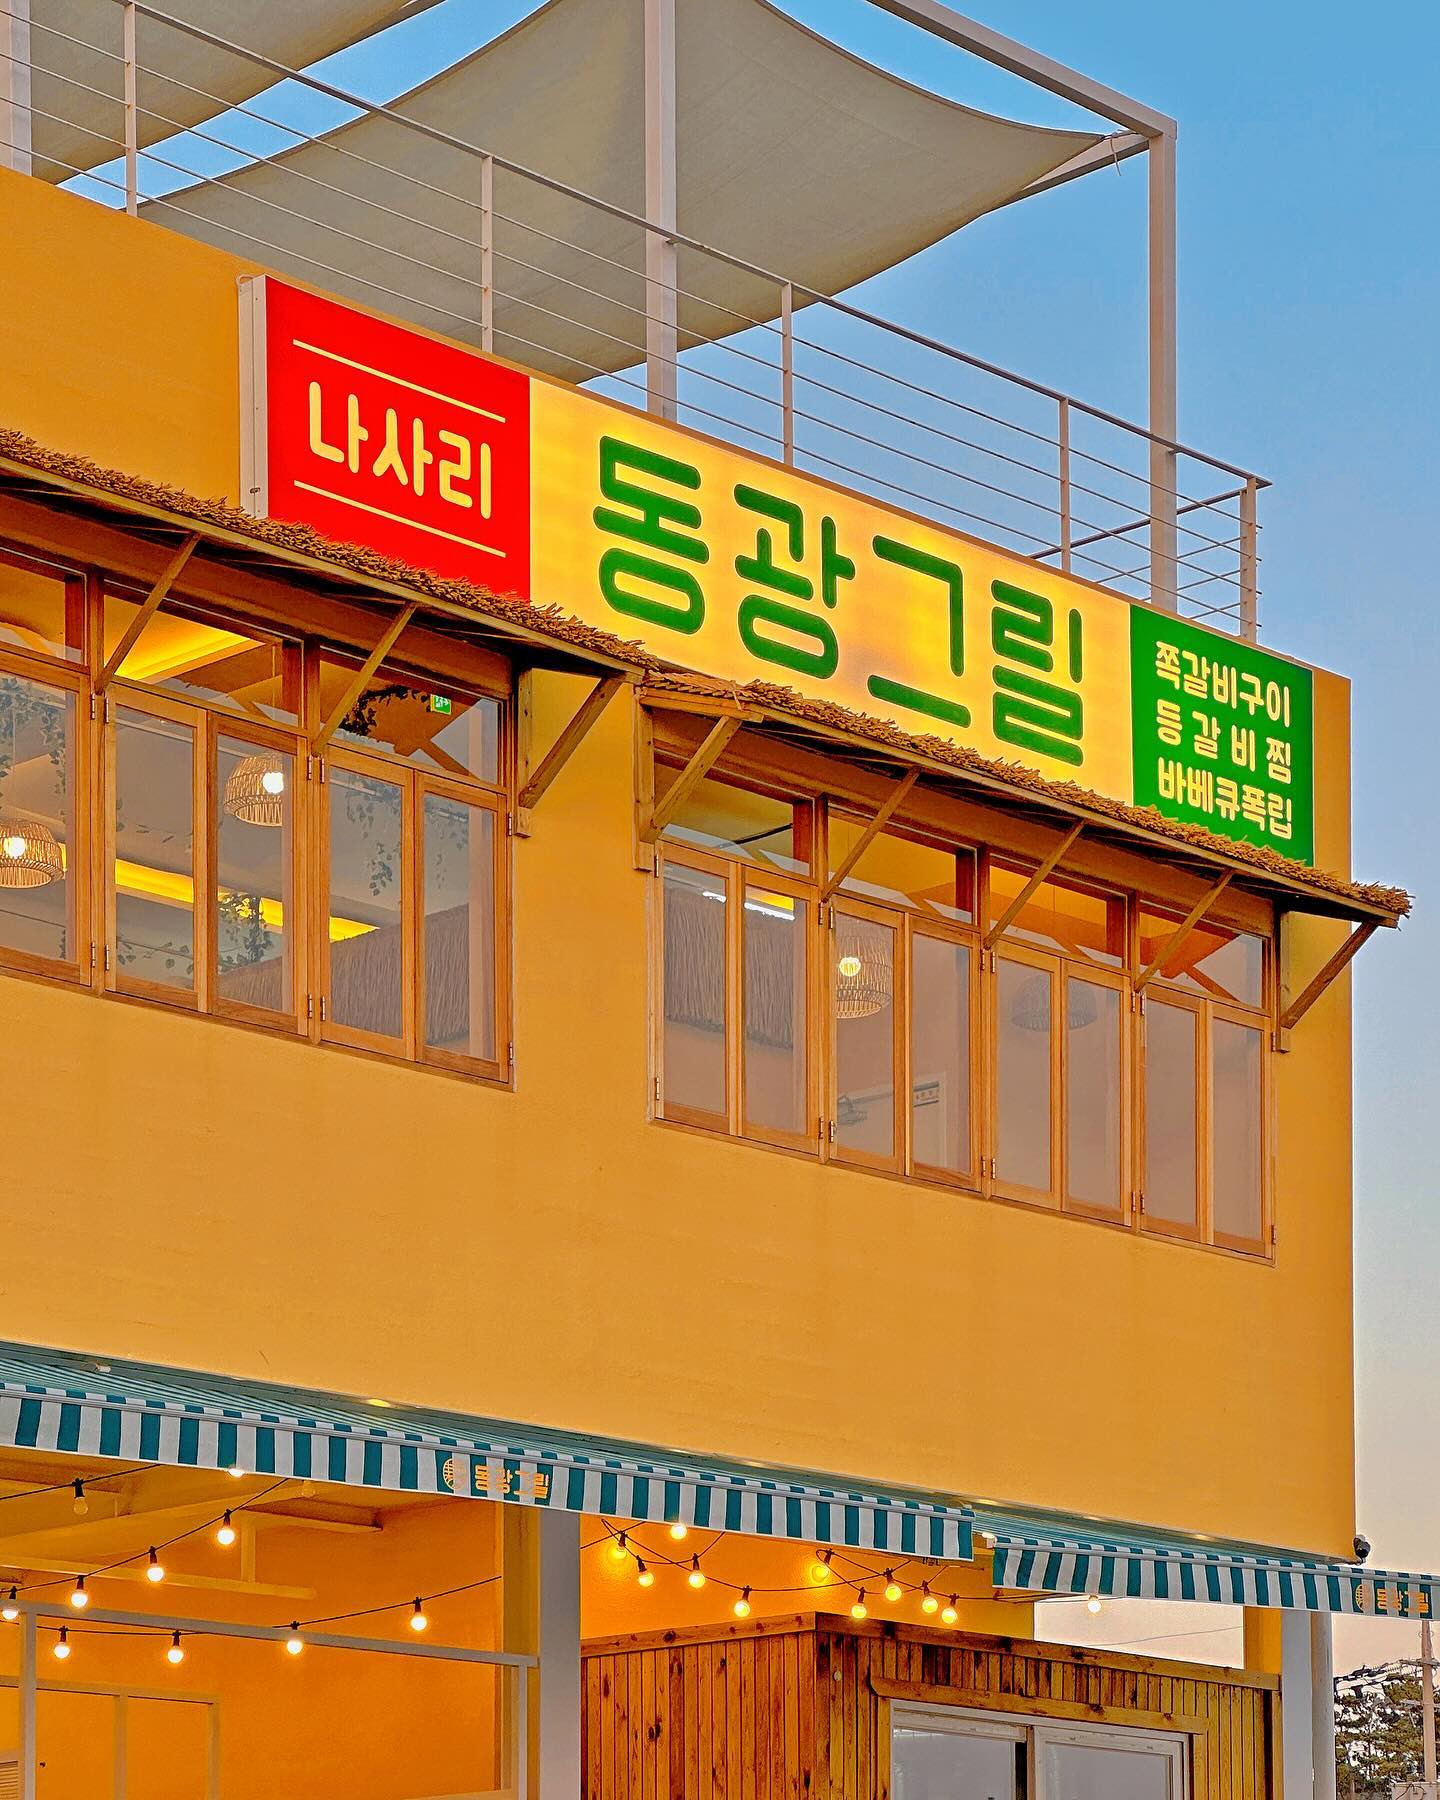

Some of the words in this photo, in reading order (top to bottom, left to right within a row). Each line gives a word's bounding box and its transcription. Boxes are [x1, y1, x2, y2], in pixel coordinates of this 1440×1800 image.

[309, 382, 491, 519] 나사리
[593, 435, 1083, 766] 동광그릴
[1156, 641, 1290, 728] 쪽갈비구이
[1158, 757, 1292, 839] 바베큐폭립
[475, 1464, 549, 1499] 동광그릴
